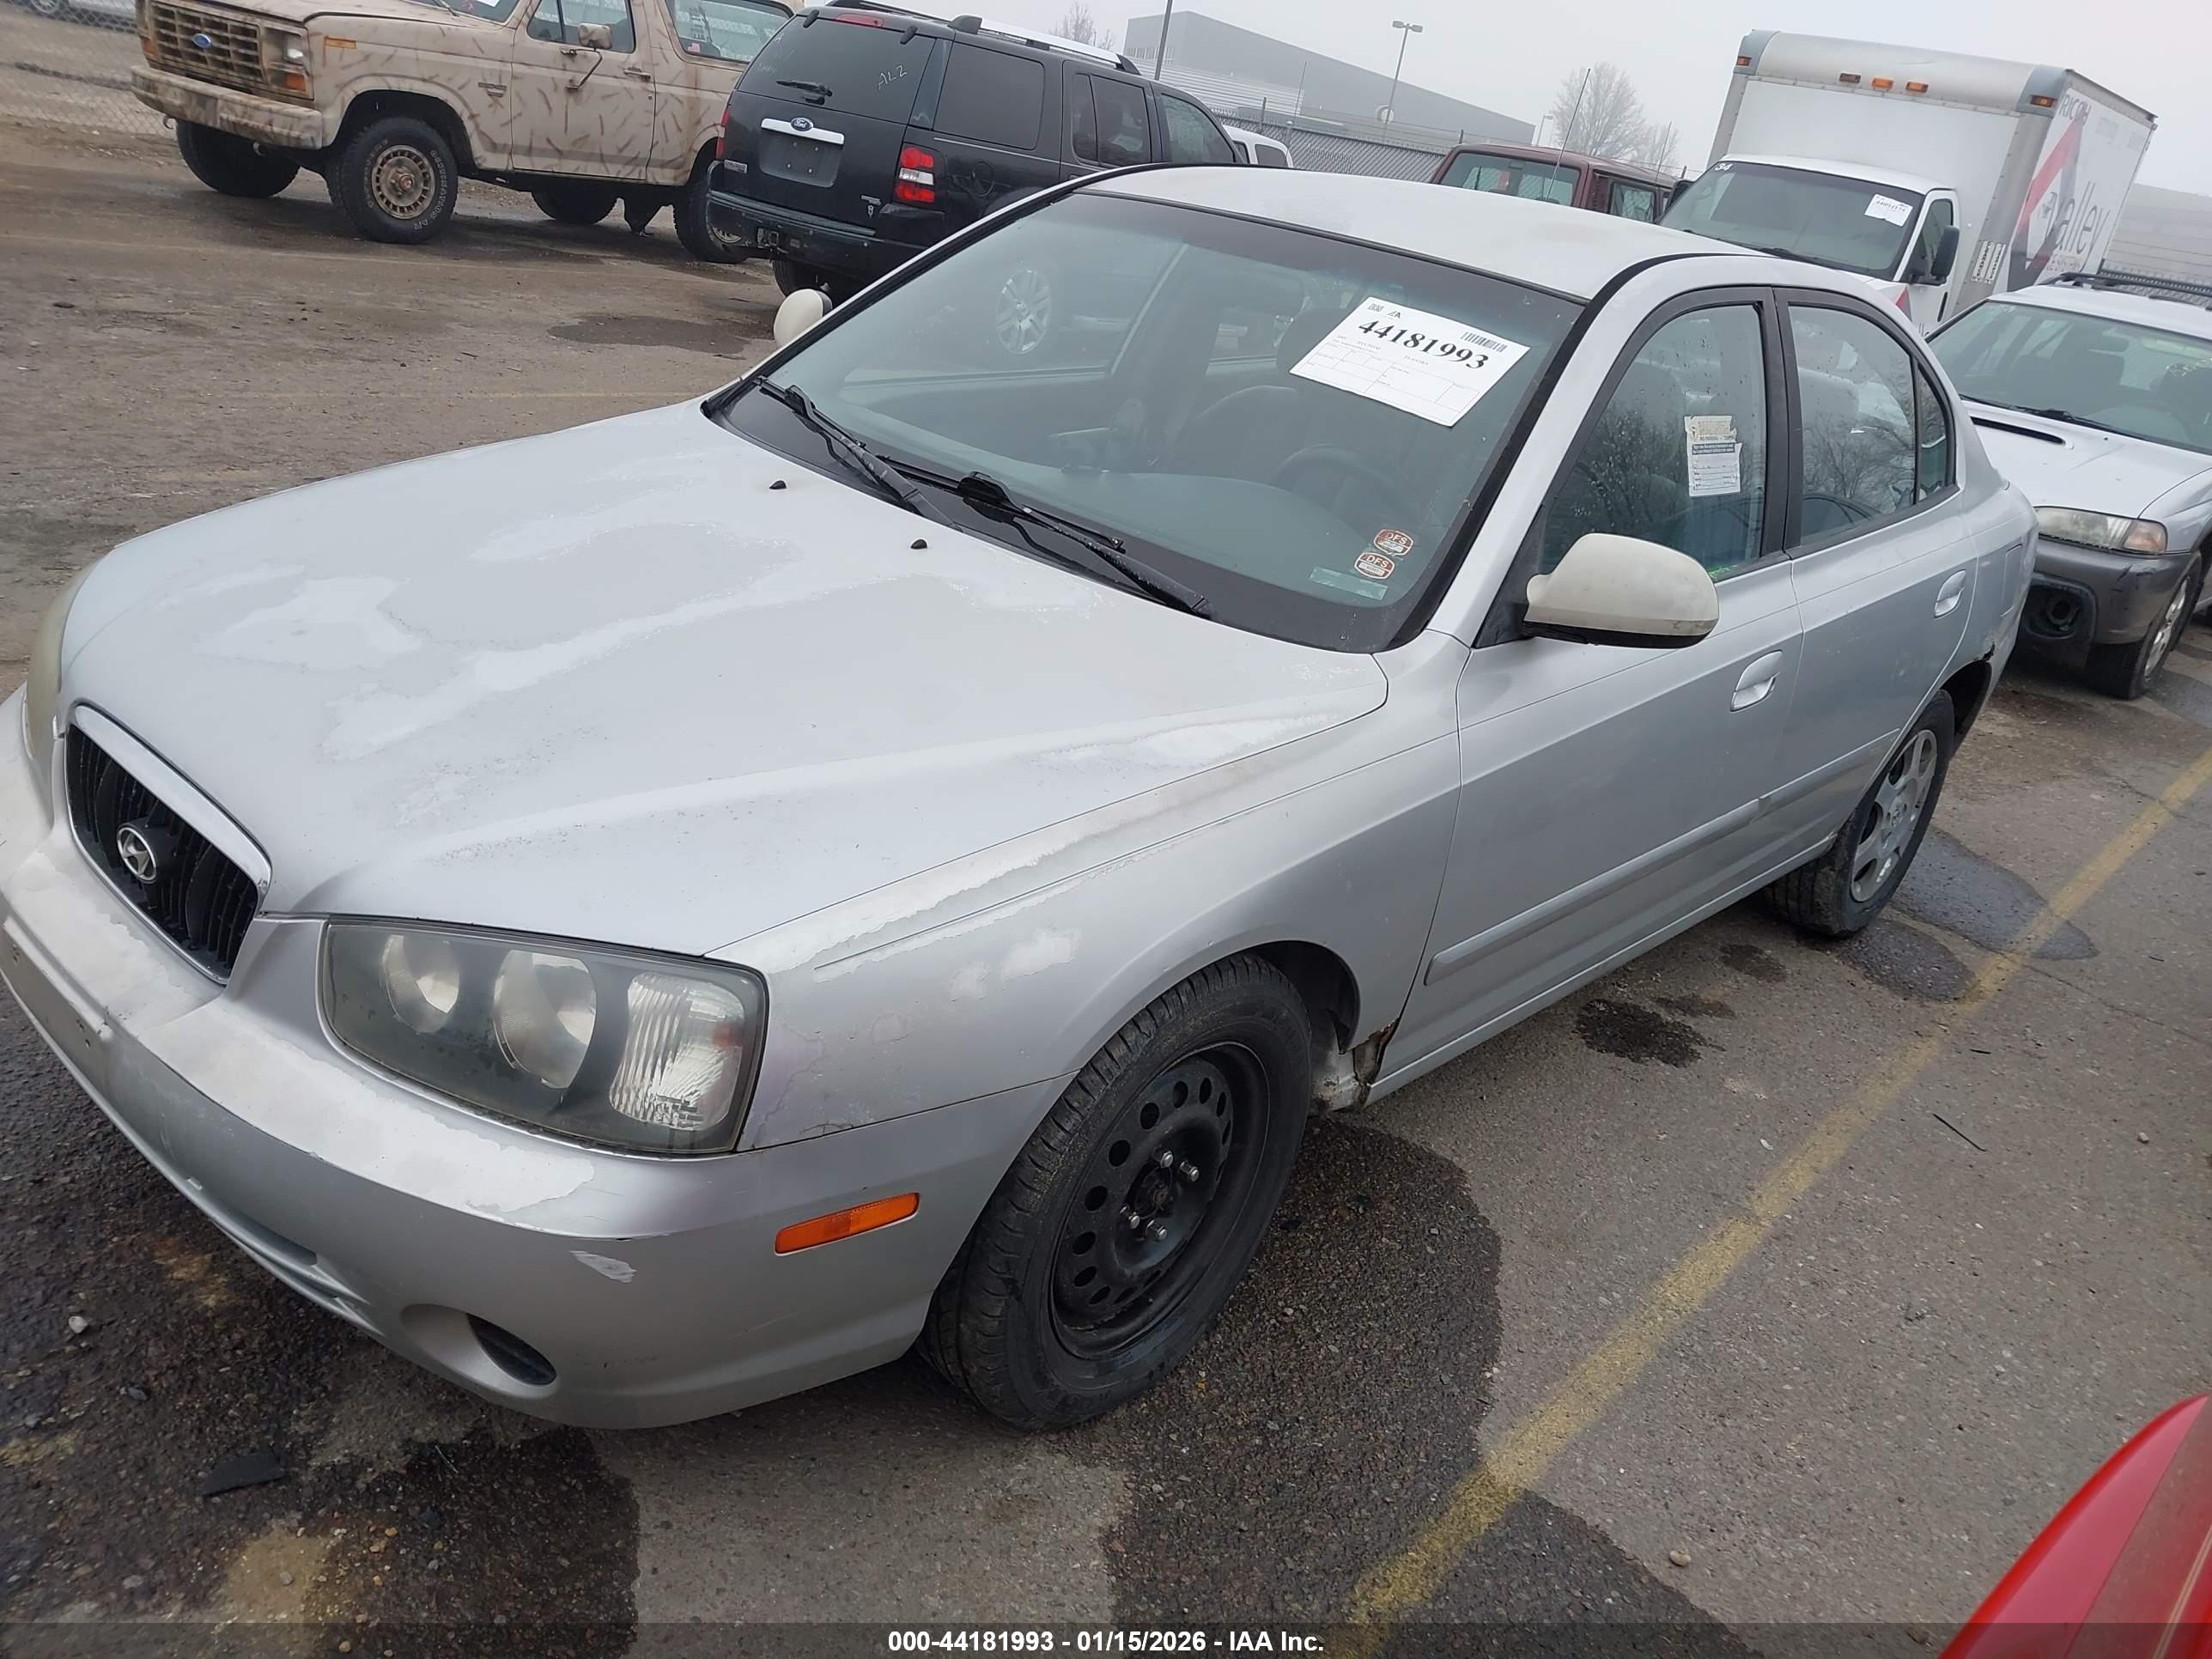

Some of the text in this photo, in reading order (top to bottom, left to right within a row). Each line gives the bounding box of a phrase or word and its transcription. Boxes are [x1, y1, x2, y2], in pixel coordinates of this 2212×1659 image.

[2059, 94, 2092, 125] RICOH
[1358, 320, 1489, 369] 44181993
[1366, 555, 1389, 568] DFS
